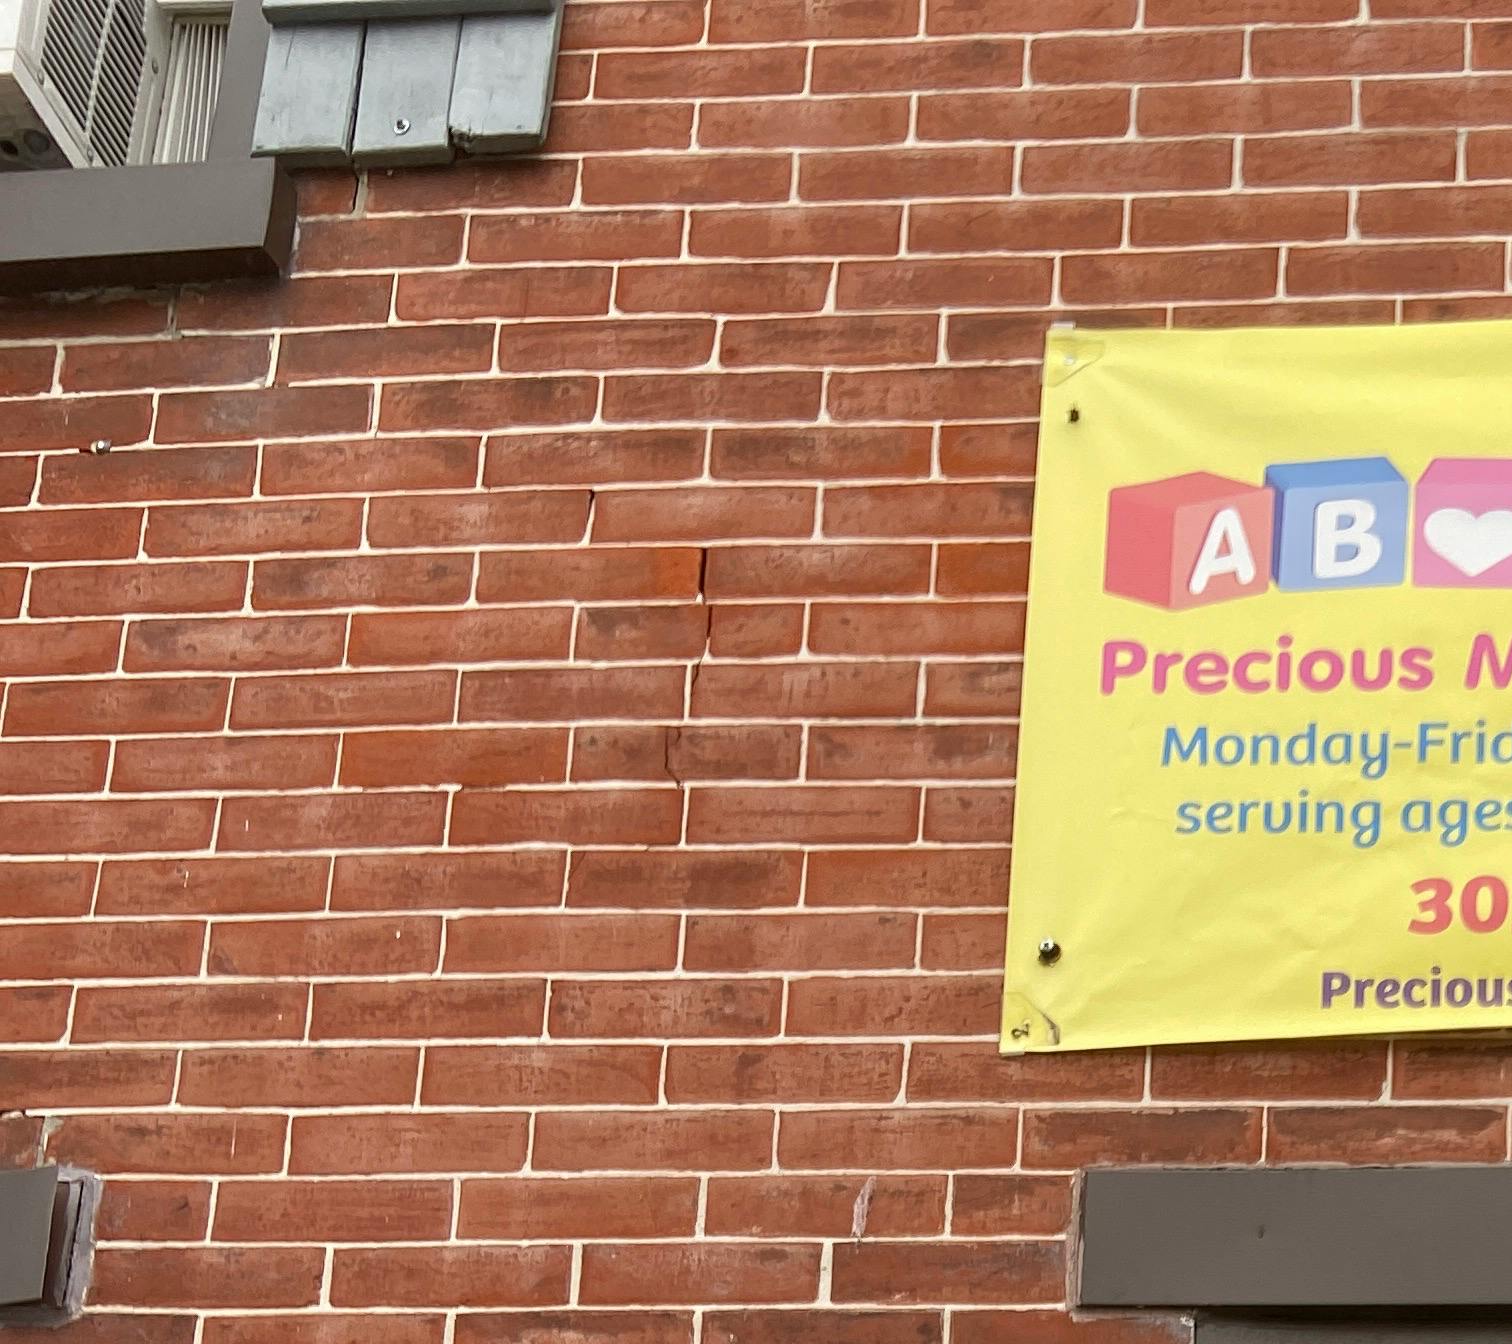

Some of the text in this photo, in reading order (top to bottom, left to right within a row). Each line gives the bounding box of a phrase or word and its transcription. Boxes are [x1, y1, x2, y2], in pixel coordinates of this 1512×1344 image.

[1188, 506, 1257, 594] A
[1312, 496, 1384, 582] B
[1101, 634, 1436, 697] Precious
[1176, 787, 1385, 850] serving
